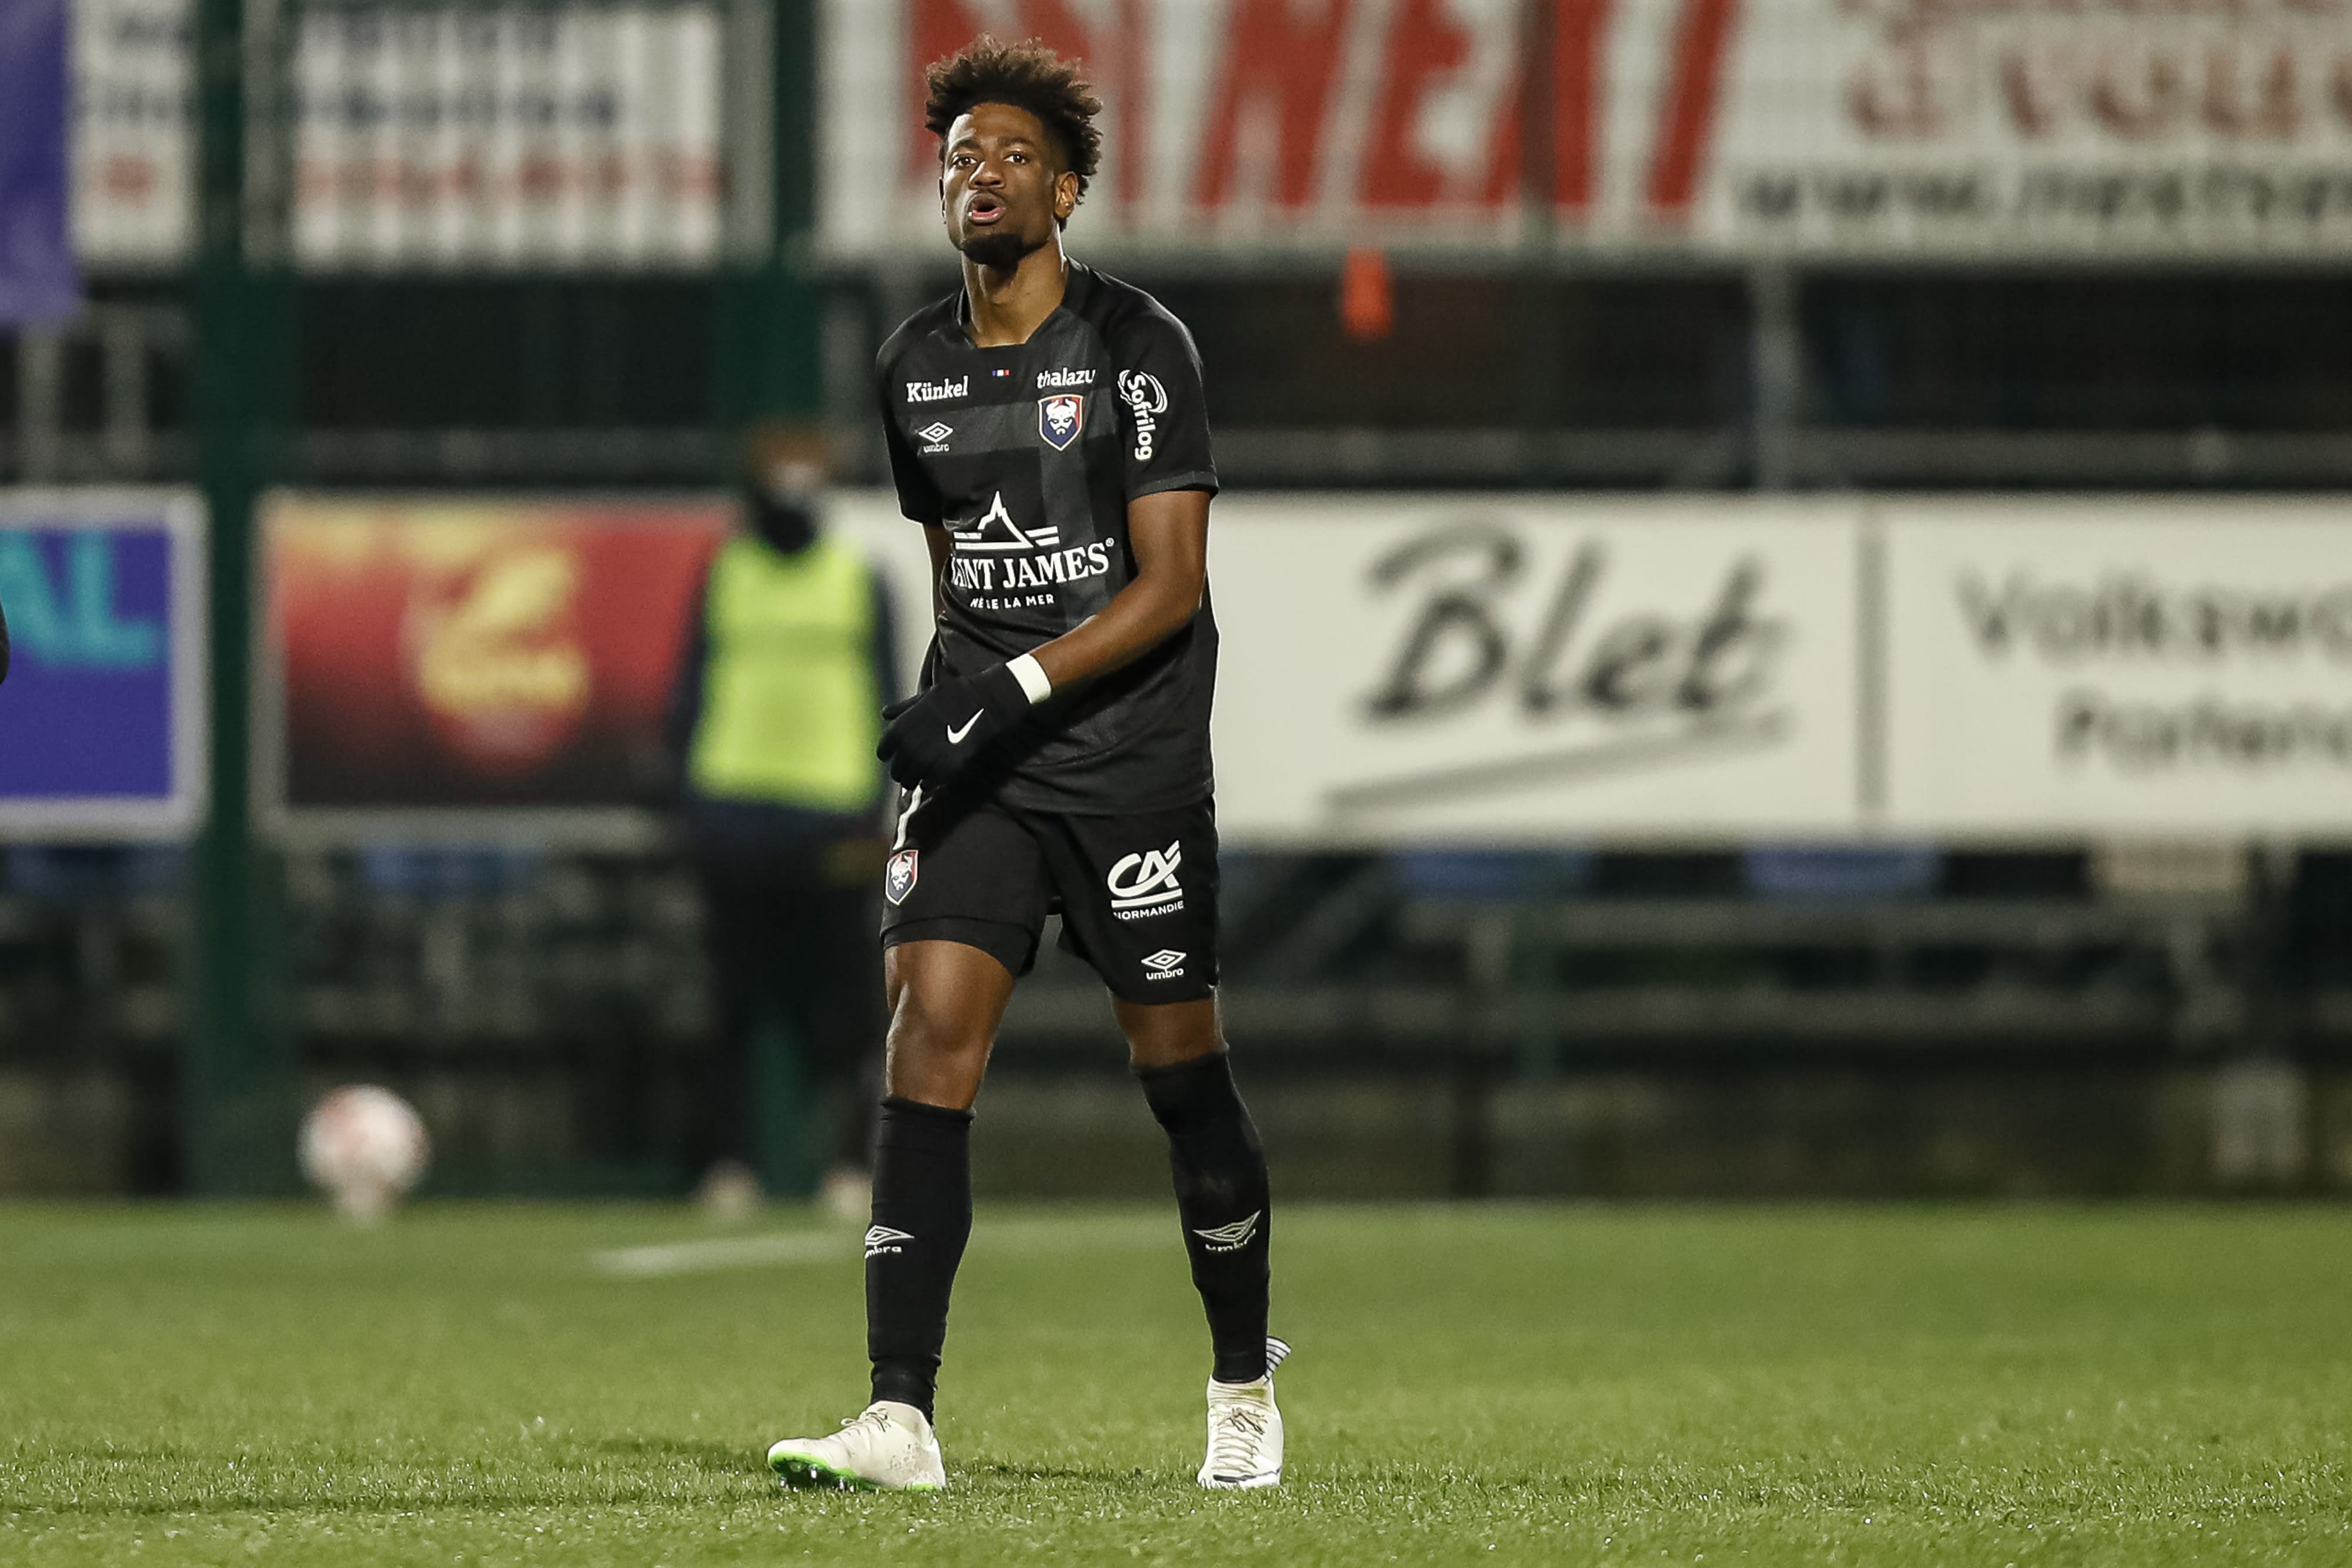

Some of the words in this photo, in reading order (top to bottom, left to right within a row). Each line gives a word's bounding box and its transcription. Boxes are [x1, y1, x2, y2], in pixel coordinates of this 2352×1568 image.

[906, 375, 968, 402] Künkel
[1037, 367, 1095, 389] thalazu
[1127, 374, 1156, 460] Sofrilog
[1004, 597, 1021, 609] LA
[1025, 593, 1054, 606] MER
[1358, 517, 1796, 723] Blet
[1147, 968, 1184, 979] umbro
